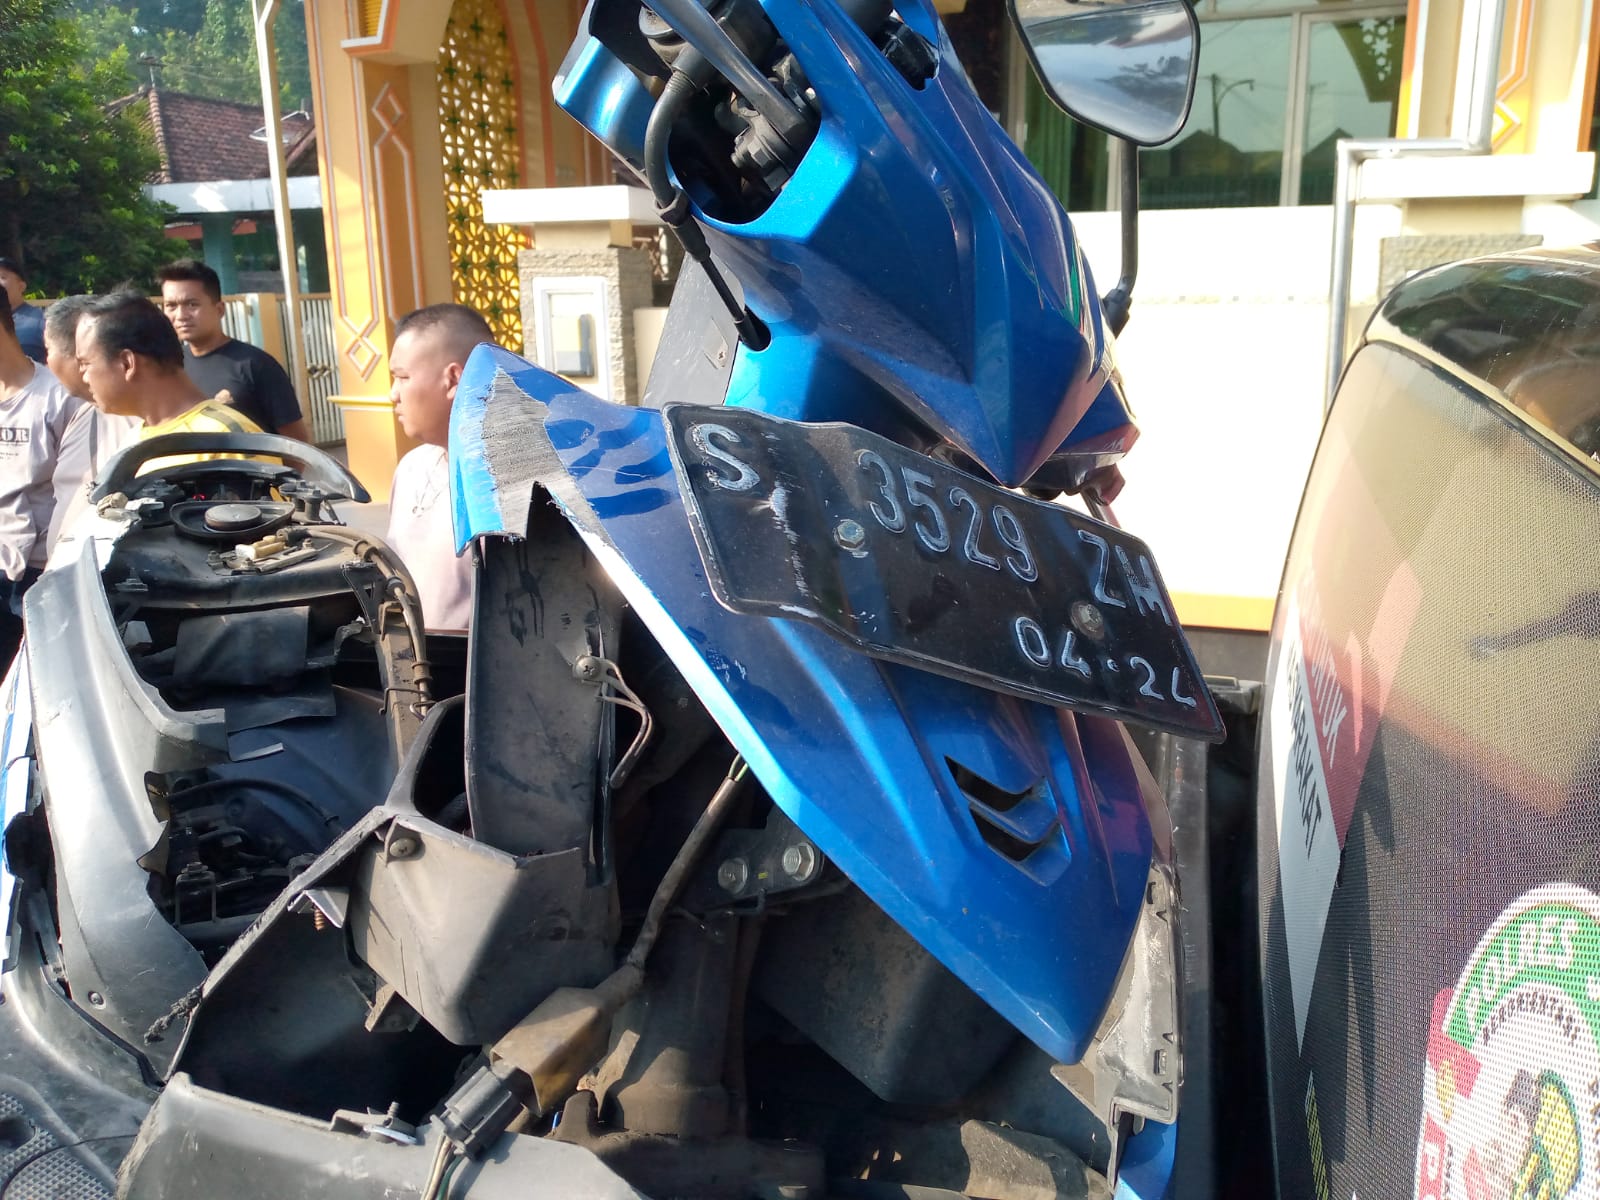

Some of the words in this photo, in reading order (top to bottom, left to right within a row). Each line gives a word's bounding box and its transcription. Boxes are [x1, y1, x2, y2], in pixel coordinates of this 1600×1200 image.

[693, 423, 760, 491] S
[857, 448, 1038, 583] 3529
[1287, 638, 1322, 861] ASYARAKAT
[1465, 916, 1580, 1032] POLRES
